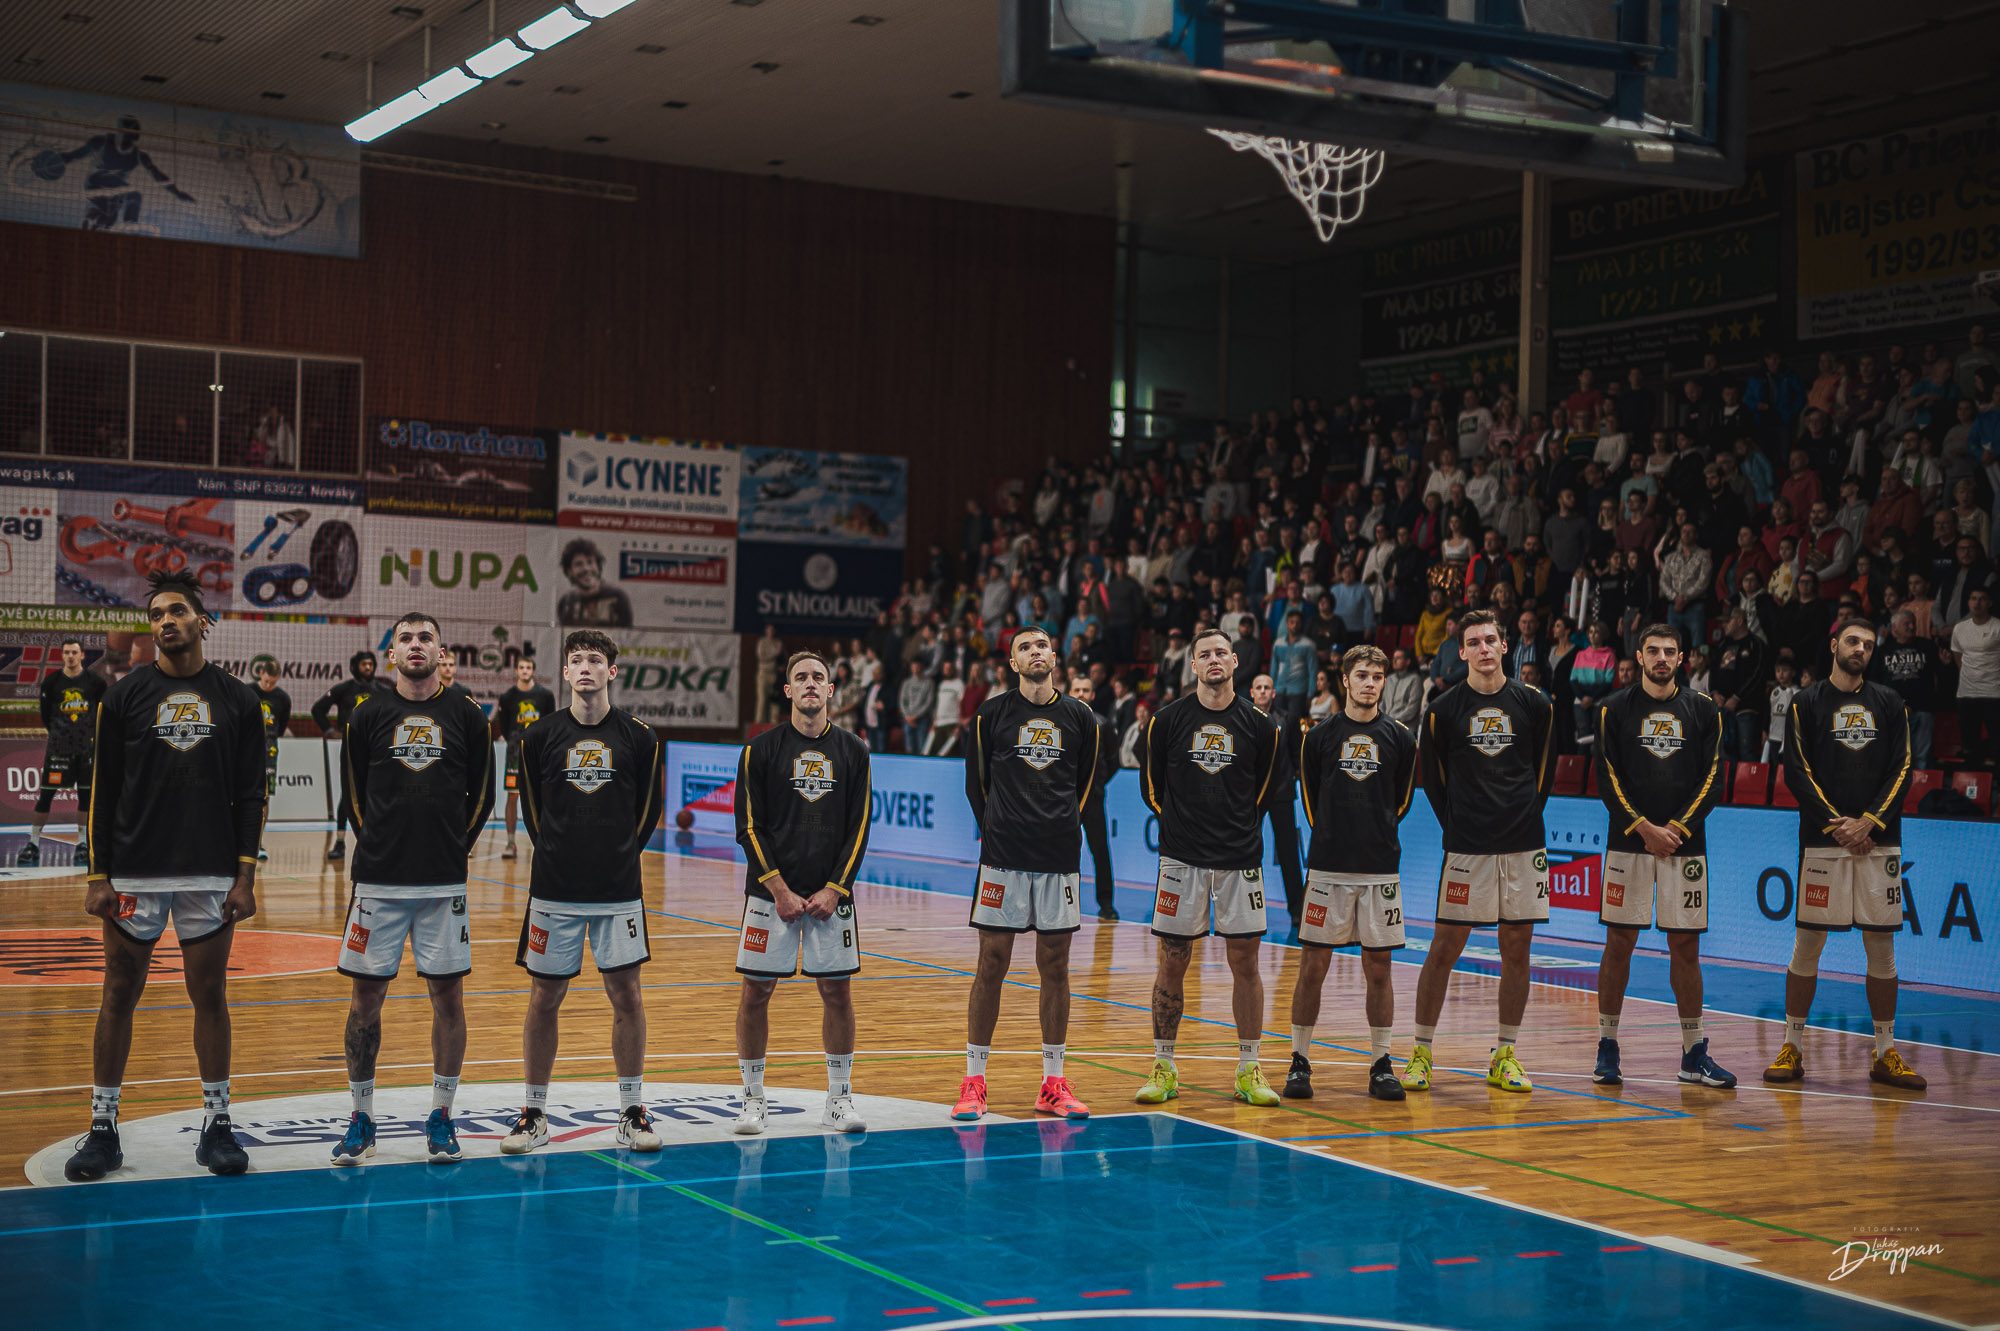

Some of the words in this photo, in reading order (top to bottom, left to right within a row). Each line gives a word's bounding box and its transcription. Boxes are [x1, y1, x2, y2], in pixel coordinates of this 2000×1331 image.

[1812, 139, 1869, 188] BC
[1568, 206, 1605, 239] BC
[1815, 190, 1943, 238] Majster
[1865, 224, 2000, 278] 1992/93
[1382, 279, 1485, 320] MAJSTER
[1397, 319, 1449, 351] 1994
[1467, 311, 1497, 338] 95
[409, 420, 547, 460] Ronchem
[606, 456, 722, 496] ICYNENE
[380, 547, 539, 593] NUPA
[626, 553, 721, 578] Slovaktual
[27, 609, 72, 622] DVERE
[76, 610, 85, 622] A
[1885, 652, 1926, 666] CASUAL
[282, 661, 342, 680] KLIMA
[617, 663, 731, 692] ADKA
[167, 703, 200, 722] 75
[1841, 713, 1868, 731] 75
[403, 725, 433, 744] 75
[1477, 716, 1504, 734] 75
[1648, 720, 1675, 737] 75
[1021, 726, 1053, 747] 75
[1200, 733, 1226, 752] 75
[576, 750, 603, 769] 75
[1221, 754, 1232, 762] 2022
[1348, 741, 1372, 760] 75
[599, 772, 611, 780] 2022
[801, 760, 825, 778] 75
[7, 766, 44, 792] DO
[1535, 856, 1547, 868] GK
[1685, 863, 1702, 878] GK
[1887, 861, 1898, 874] G
[983, 886, 1002, 900] niké
[1064, 885, 1074, 905] 9
[1248, 890, 1264, 911] 13
[1448, 885, 1467, 898] niké
[1683, 890, 1703, 908] 28
[1807, 888, 1827, 900] niké
[1886, 886, 1901, 905] 93
[1159, 896, 1177, 909] niké
[1307, 906, 1324, 920] niké
[1384, 908, 1402, 926] 22
[626, 918, 638, 939] 5
[746, 931, 766, 945] niké
[843, 929, 852, 948] 8
